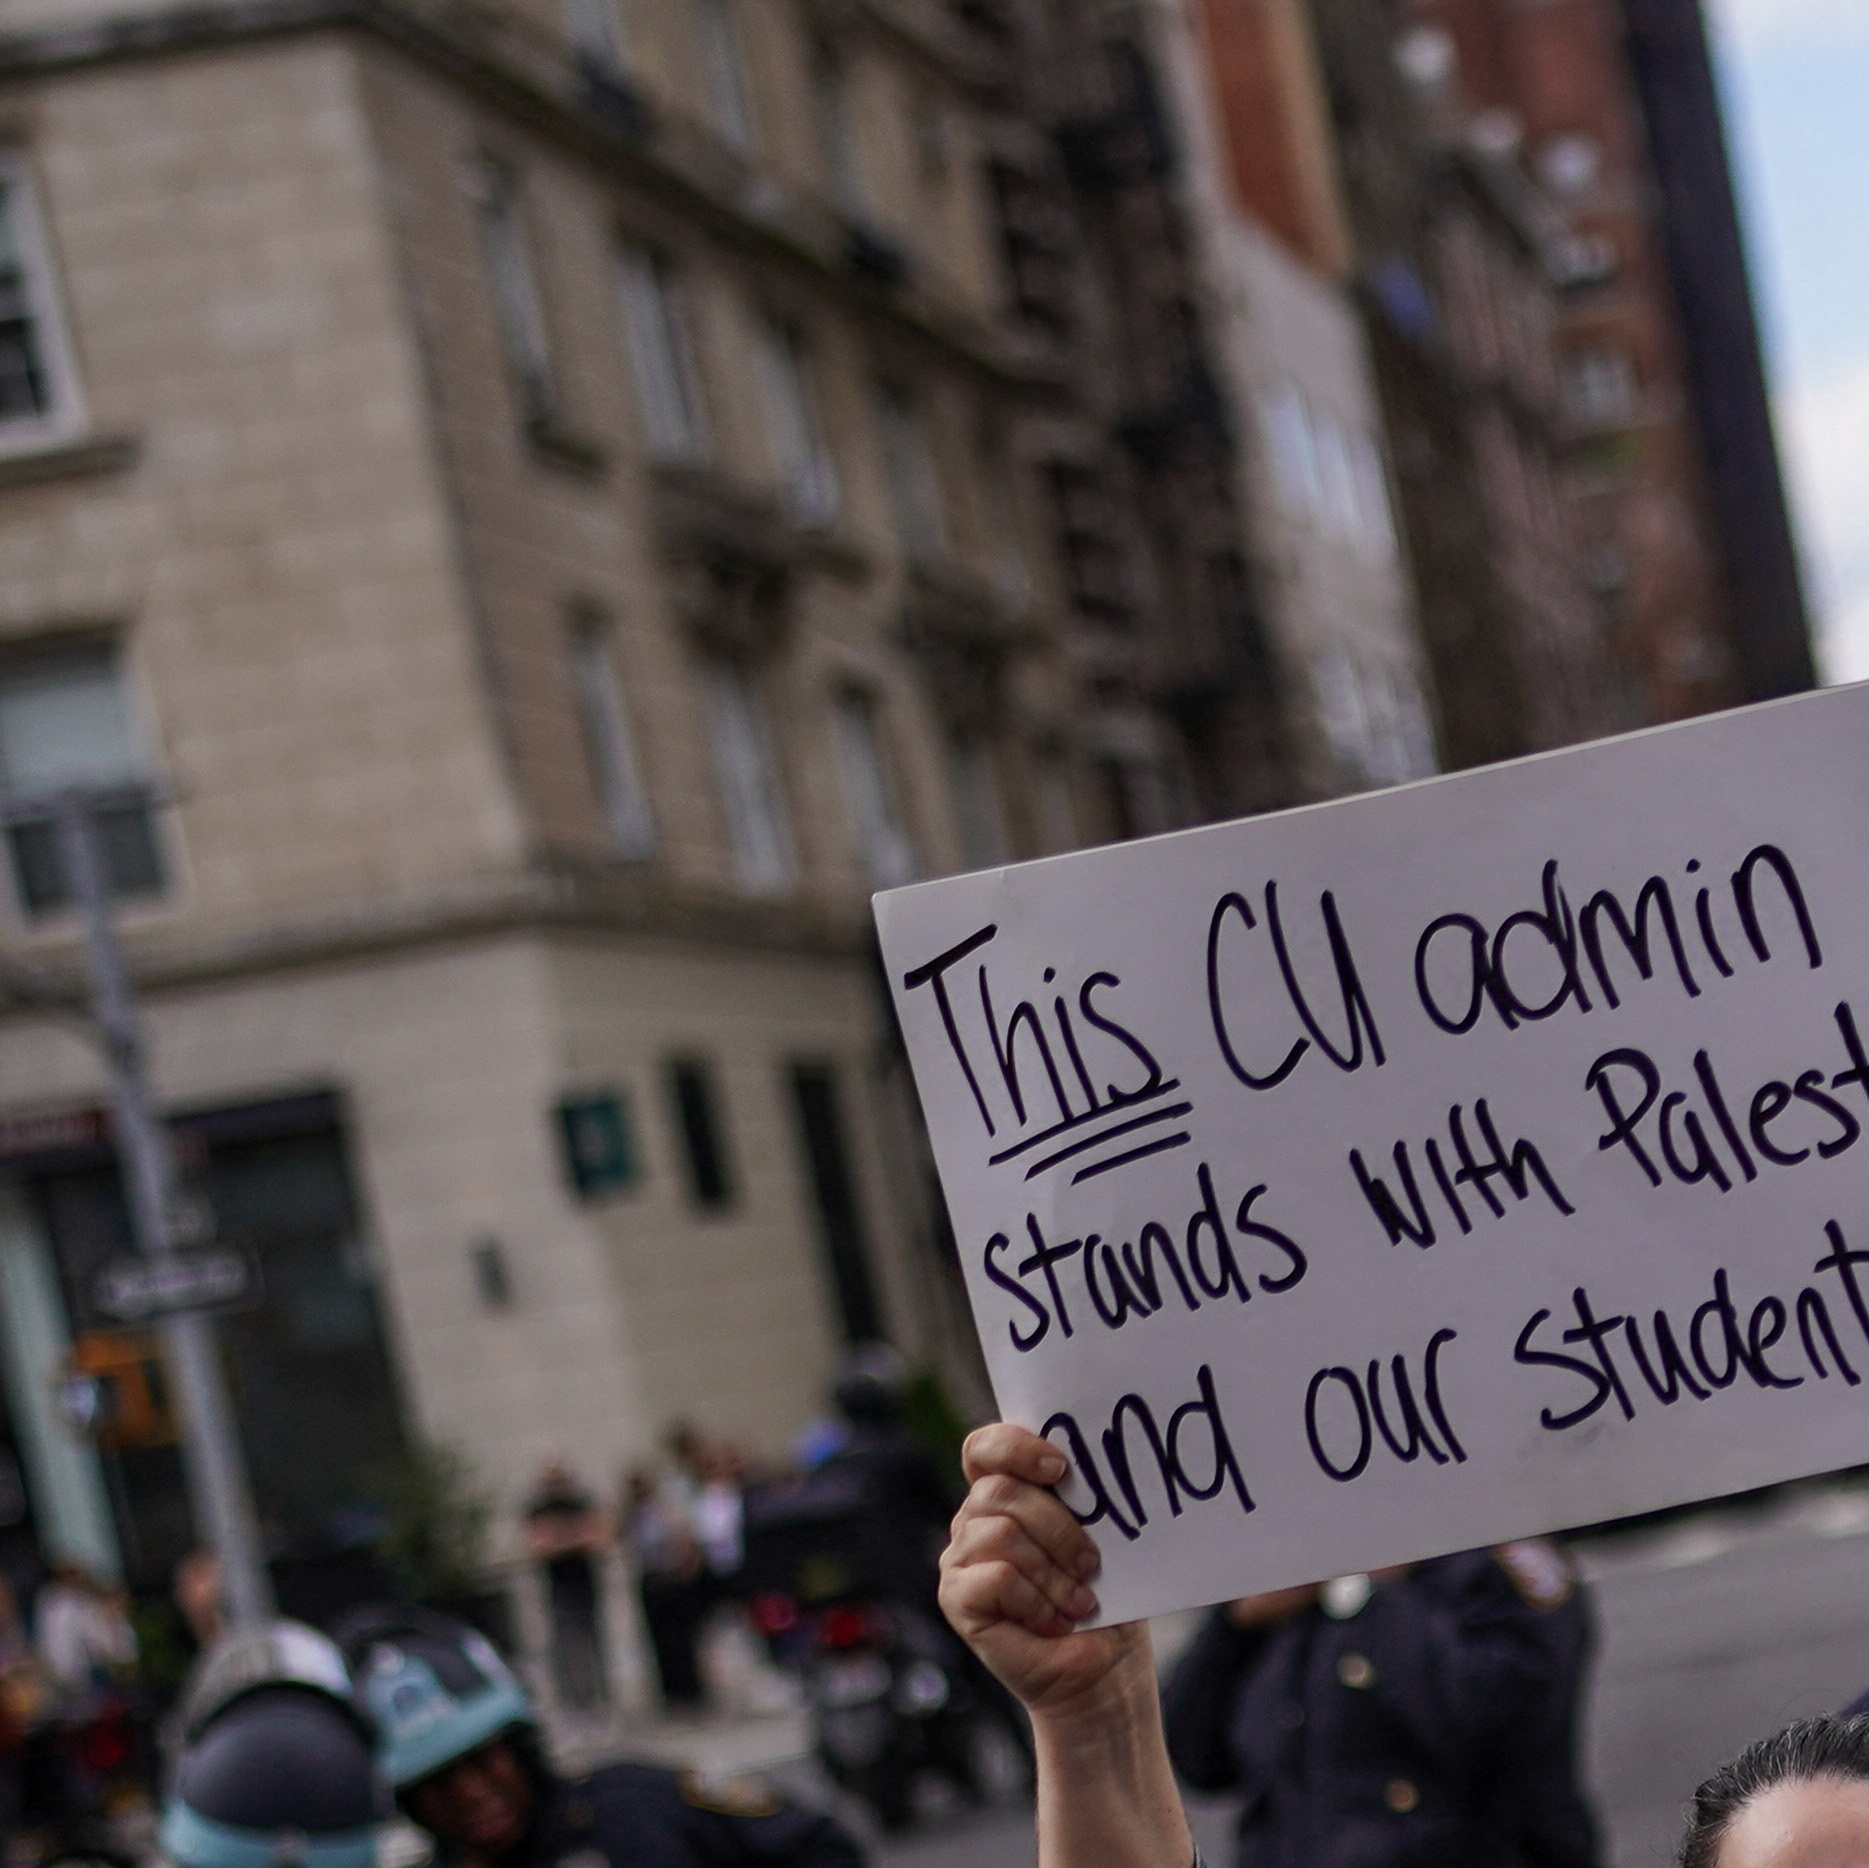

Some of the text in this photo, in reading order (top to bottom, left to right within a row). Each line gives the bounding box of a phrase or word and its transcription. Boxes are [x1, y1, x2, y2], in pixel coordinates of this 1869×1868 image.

[904, 843, 1824, 1138] This CU admin
[983, 1163, 1308, 1352] stands
[1037, 1365, 1256, 1543] and
[1302, 1326, 1468, 1483] our
